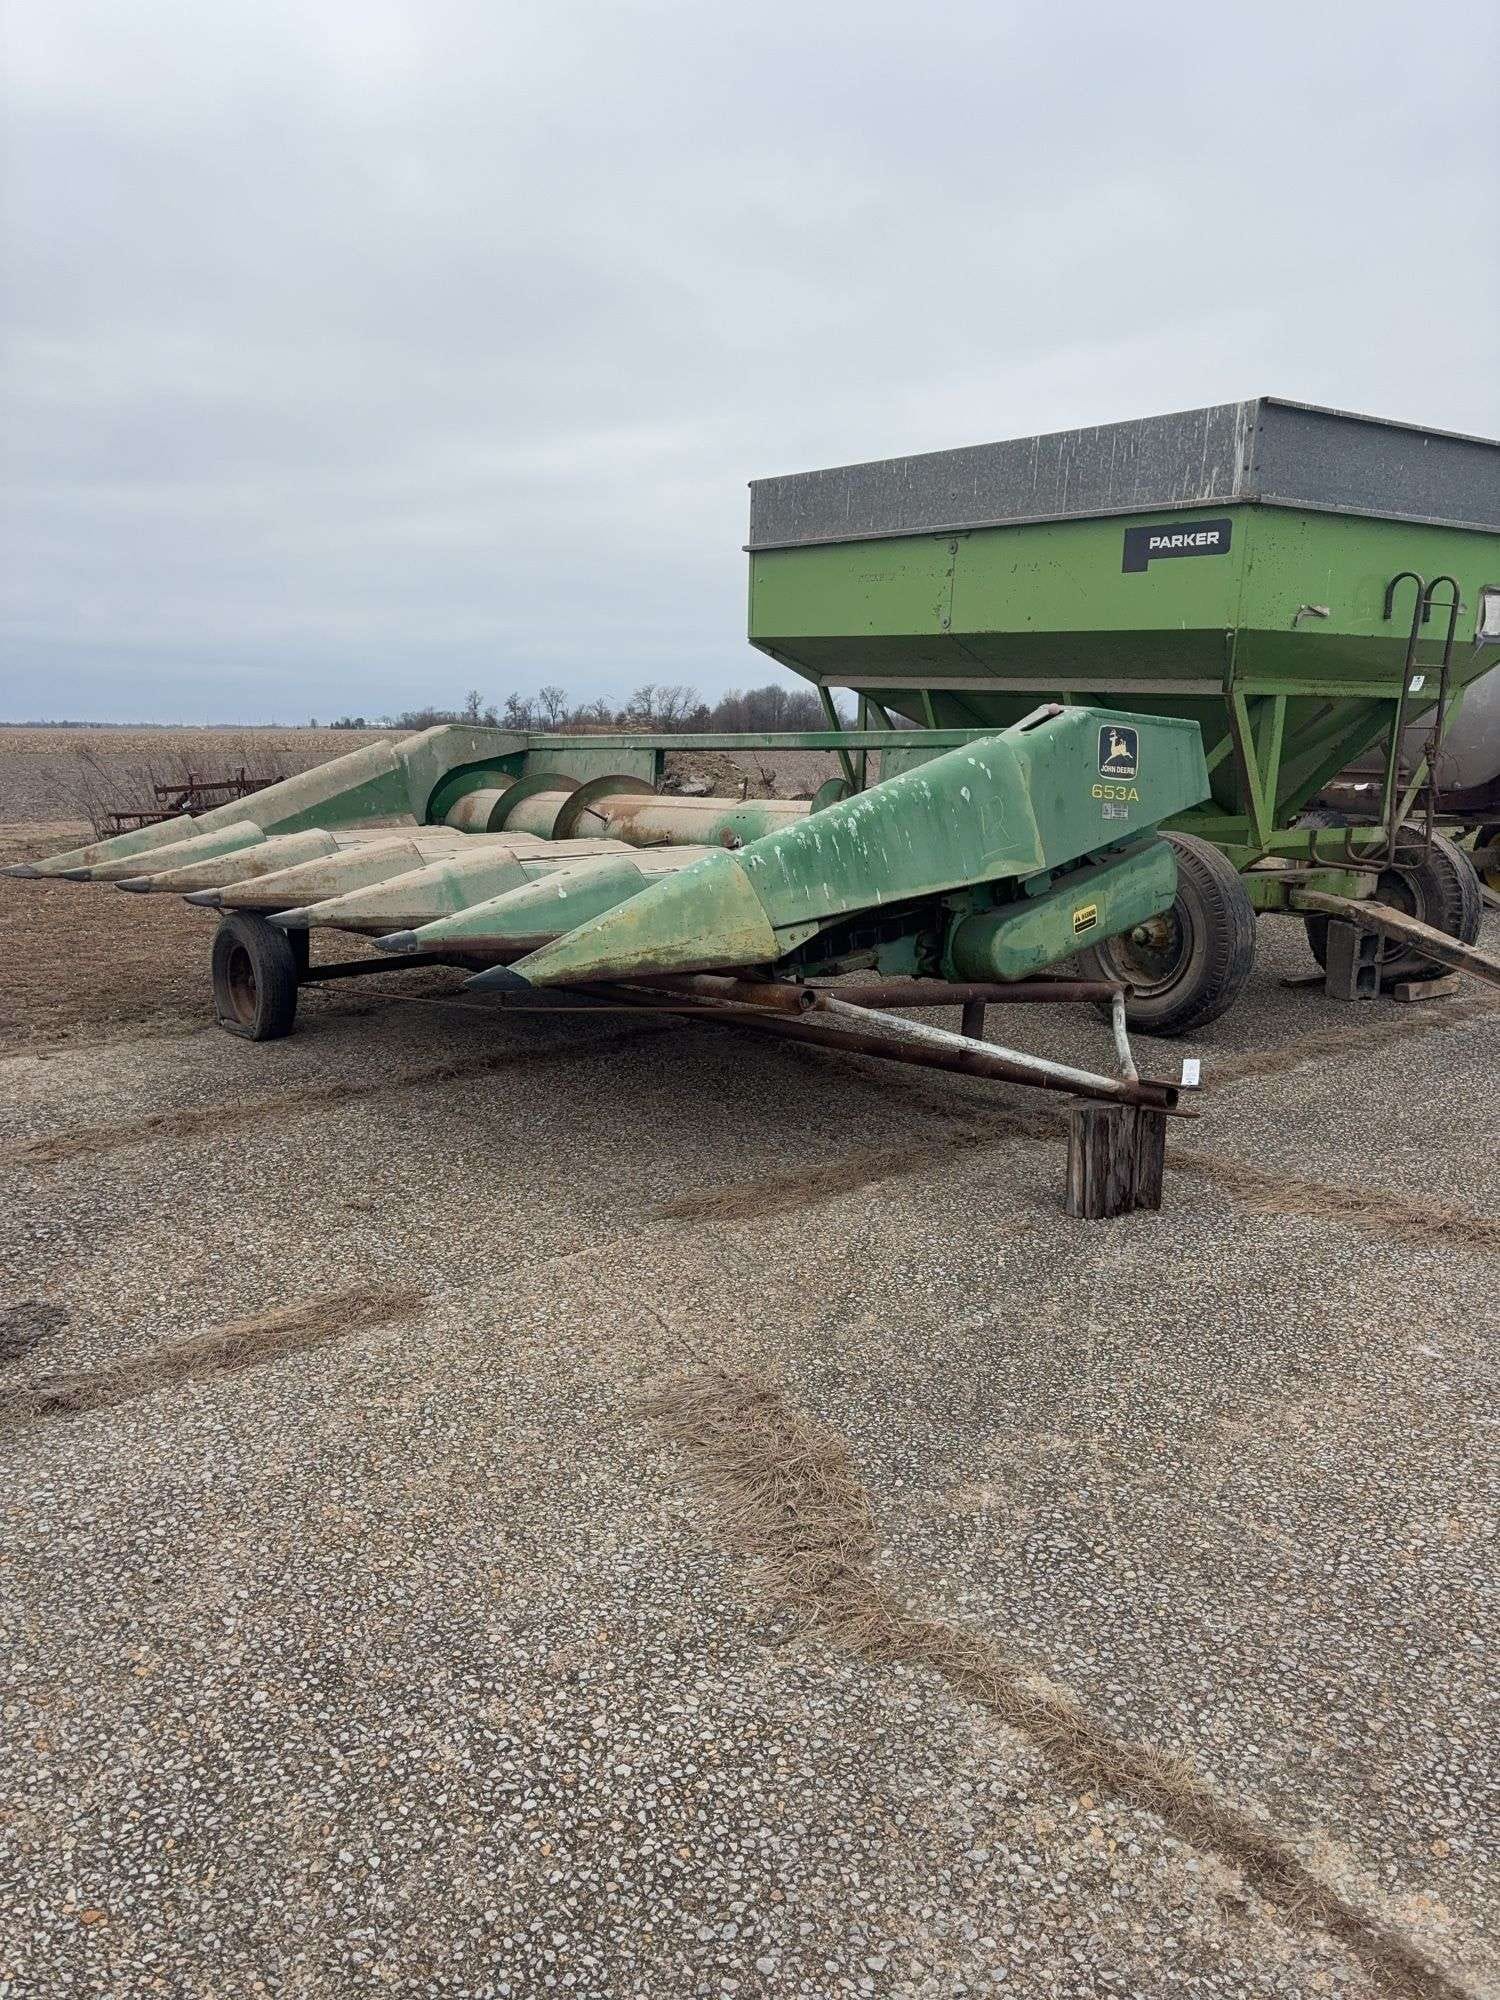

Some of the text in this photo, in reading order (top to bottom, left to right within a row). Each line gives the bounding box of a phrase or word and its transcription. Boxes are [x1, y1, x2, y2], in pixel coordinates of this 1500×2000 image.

[1149, 531, 1220, 549] PARKER
[1101, 765, 1135, 775] JOHN DEERE
[1091, 784, 1139, 802] 653A
